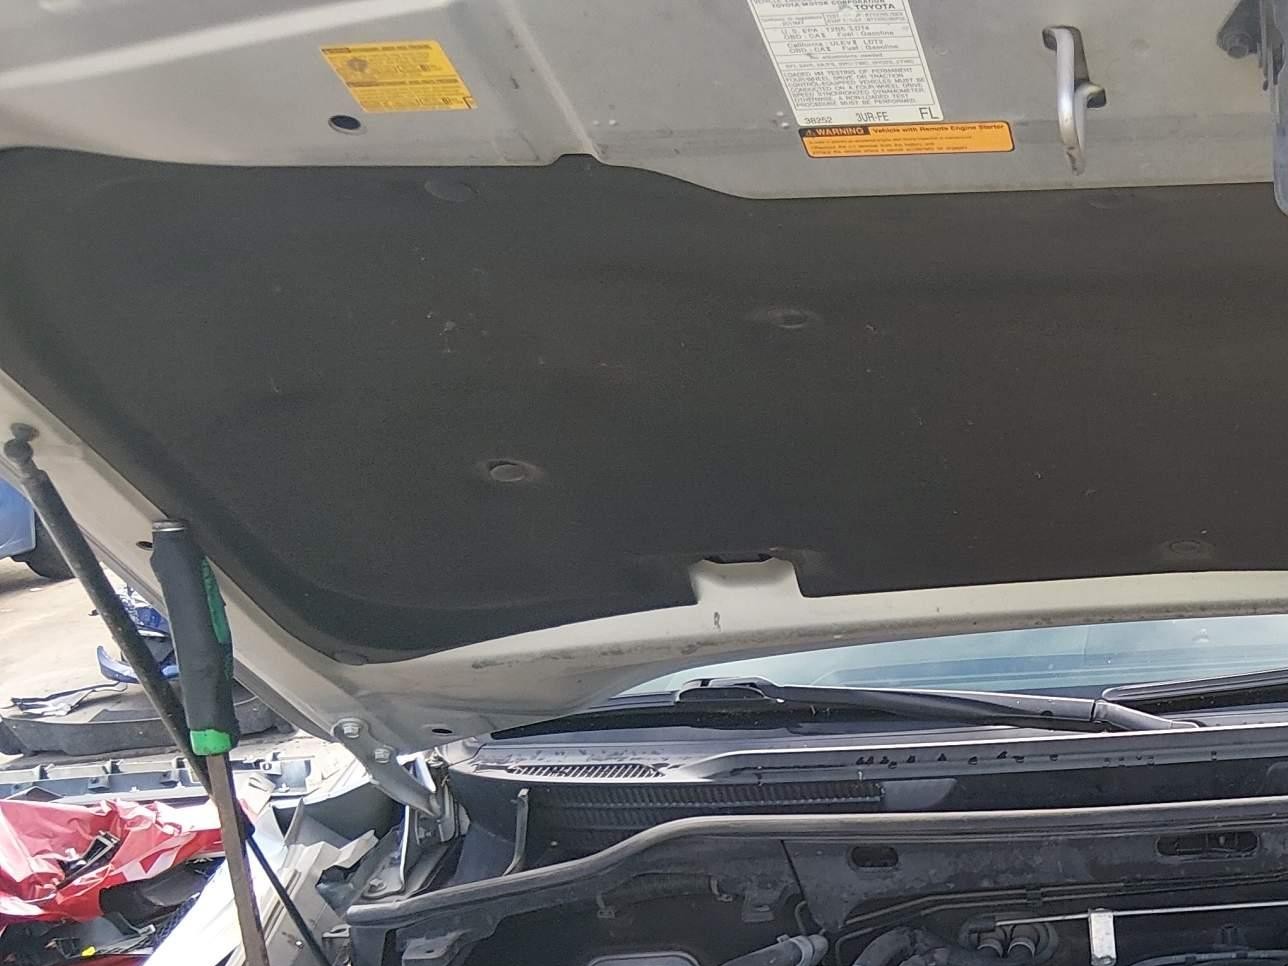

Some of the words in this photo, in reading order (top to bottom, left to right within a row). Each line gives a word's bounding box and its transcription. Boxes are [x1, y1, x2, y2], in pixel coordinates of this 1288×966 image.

[856, 112, 889, 122] 3UR-FE
[918, 107, 939, 120] FL
[816, 127, 865, 136] WARNING
